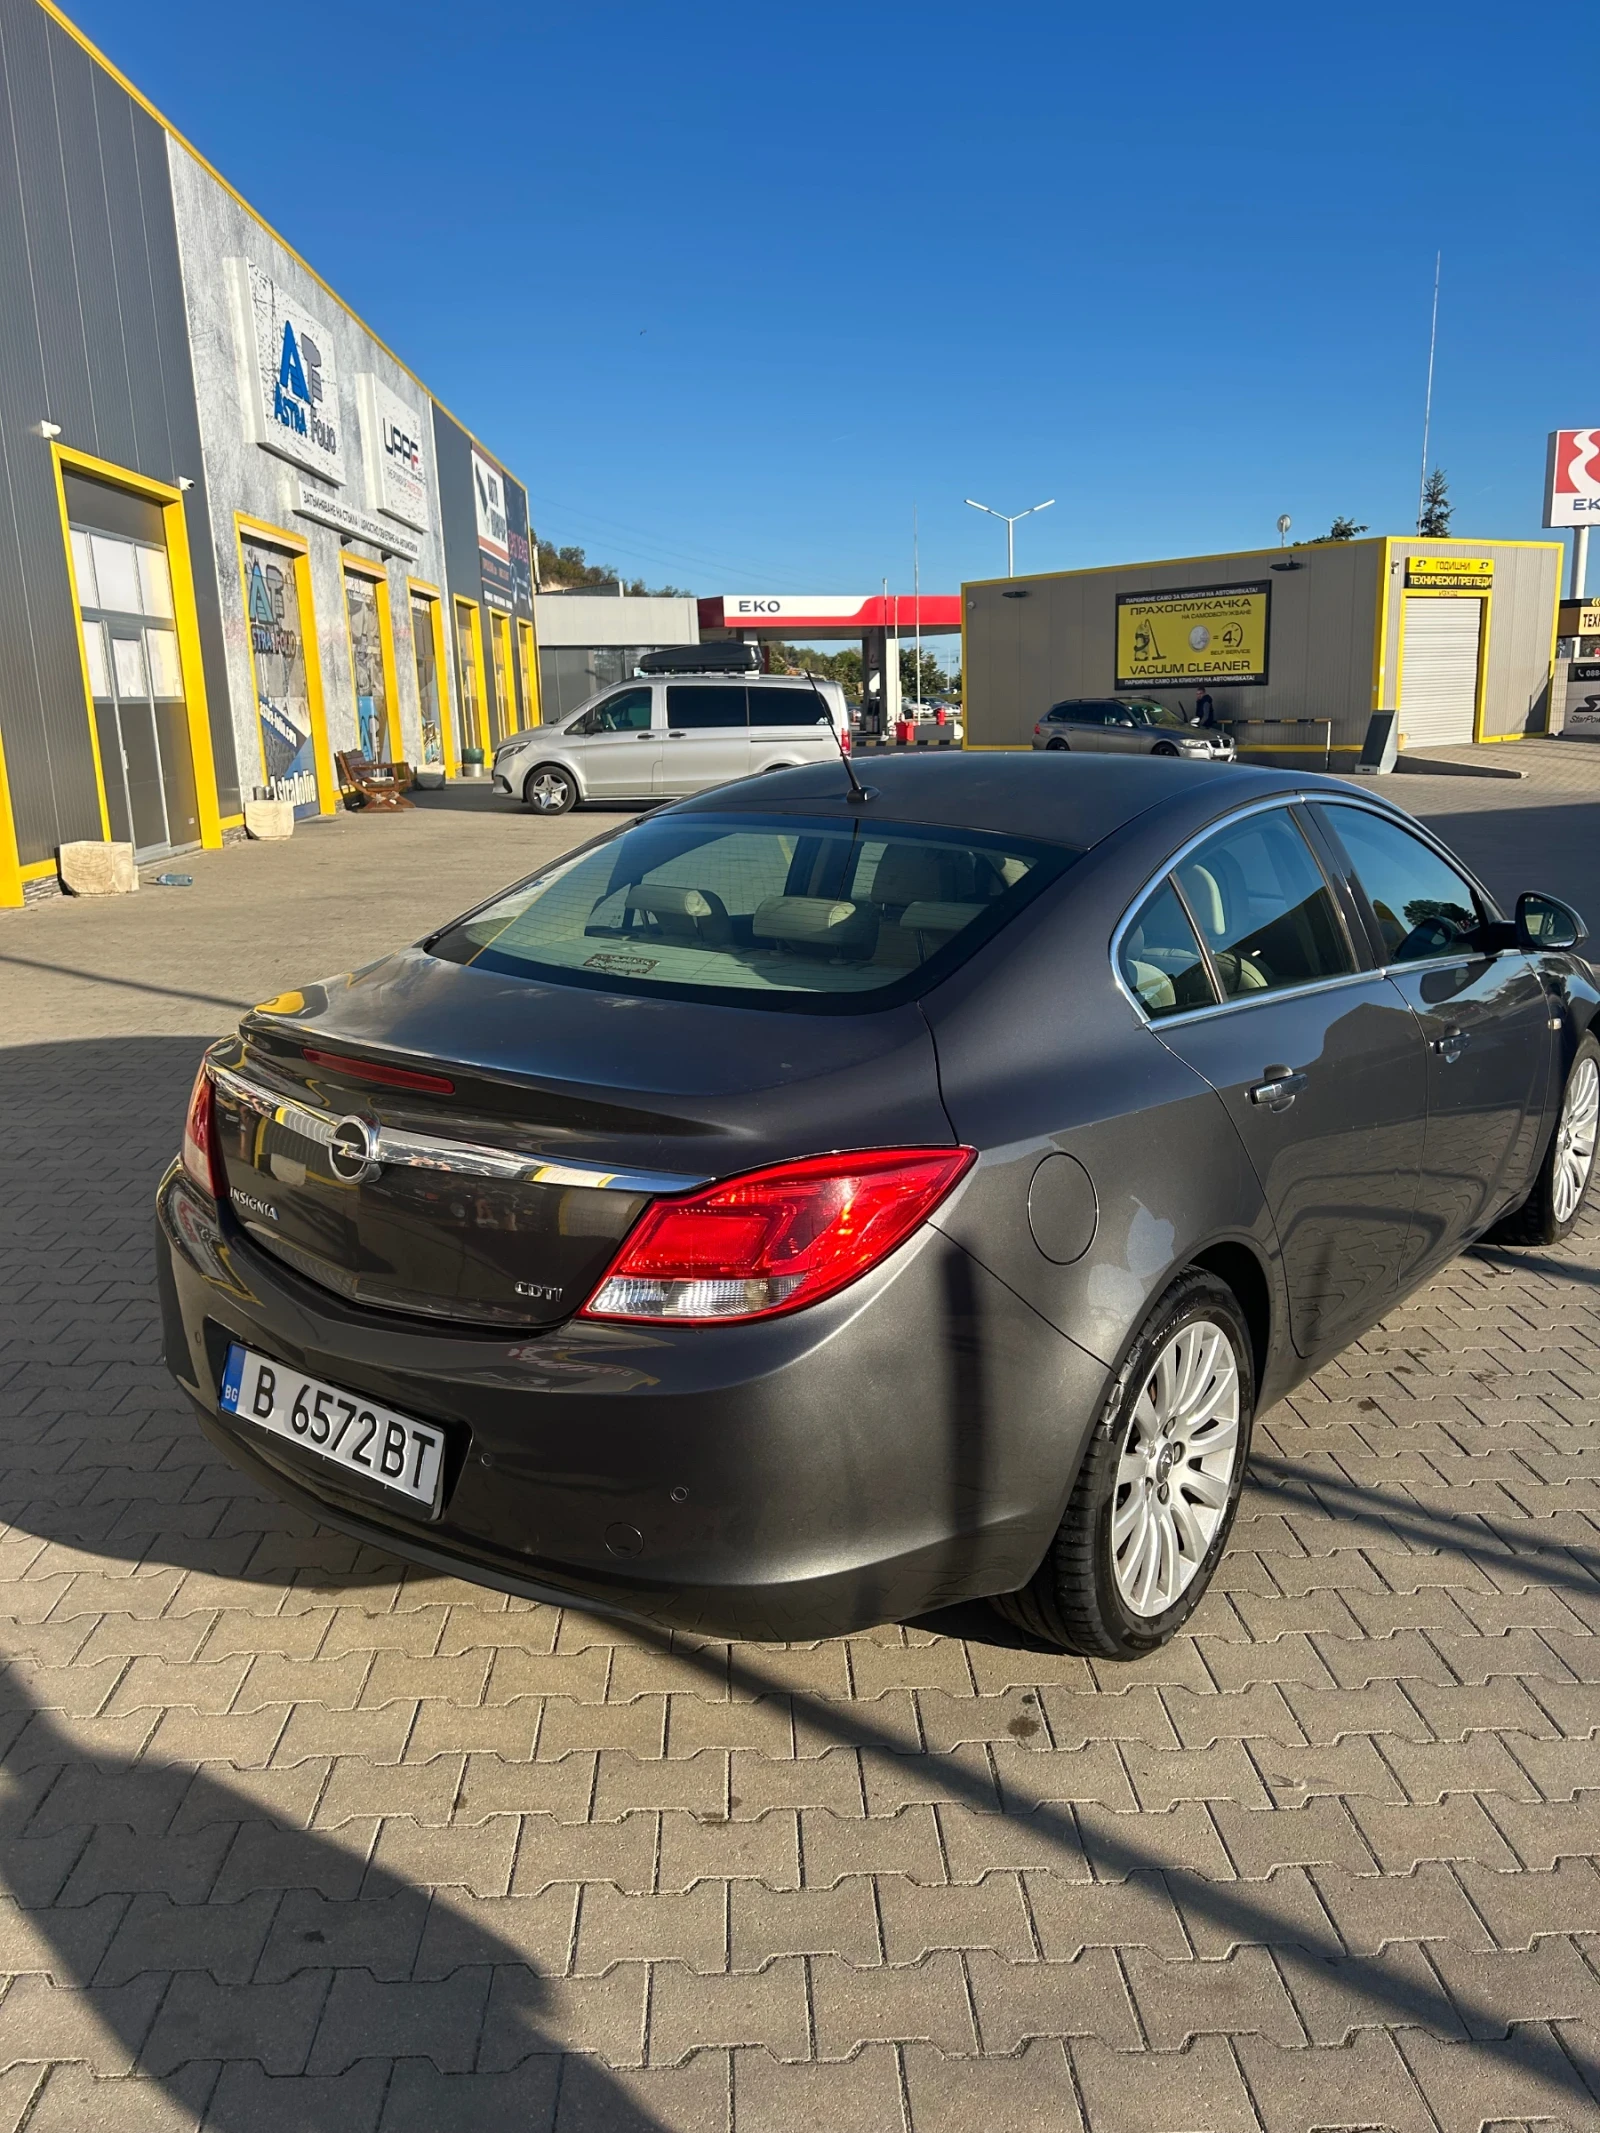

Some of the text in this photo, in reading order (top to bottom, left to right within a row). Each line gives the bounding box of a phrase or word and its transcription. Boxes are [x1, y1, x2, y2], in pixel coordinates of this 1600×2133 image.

[274, 382, 308, 438] ASTRA
[382, 418, 419, 471] UPPF
[1436, 561, 1471, 571] ГОДИШНИ
[1409, 575, 1492, 587] ТЕХНИЧЕСКИ ПРЕГЛЕДИ
[739, 600, 781, 613] EKO
[1126, 596, 1156, 604] ПАРКИРАНЕ
[1130, 598, 1252, 615] ПРАХОСМУКАЧКА
[1191, 609, 1252, 619] САМООБСЛУЖВАНЕ
[1222, 630, 1232, 644] 4
[1130, 660, 1250, 675] VACUUM CLEANER
[230, 1186, 279, 1221] INSIGNIA
[515, 1281, 563, 1302] CDTI
[225, 1384, 238, 1402] BG
[253, 1365, 276, 1419] B
